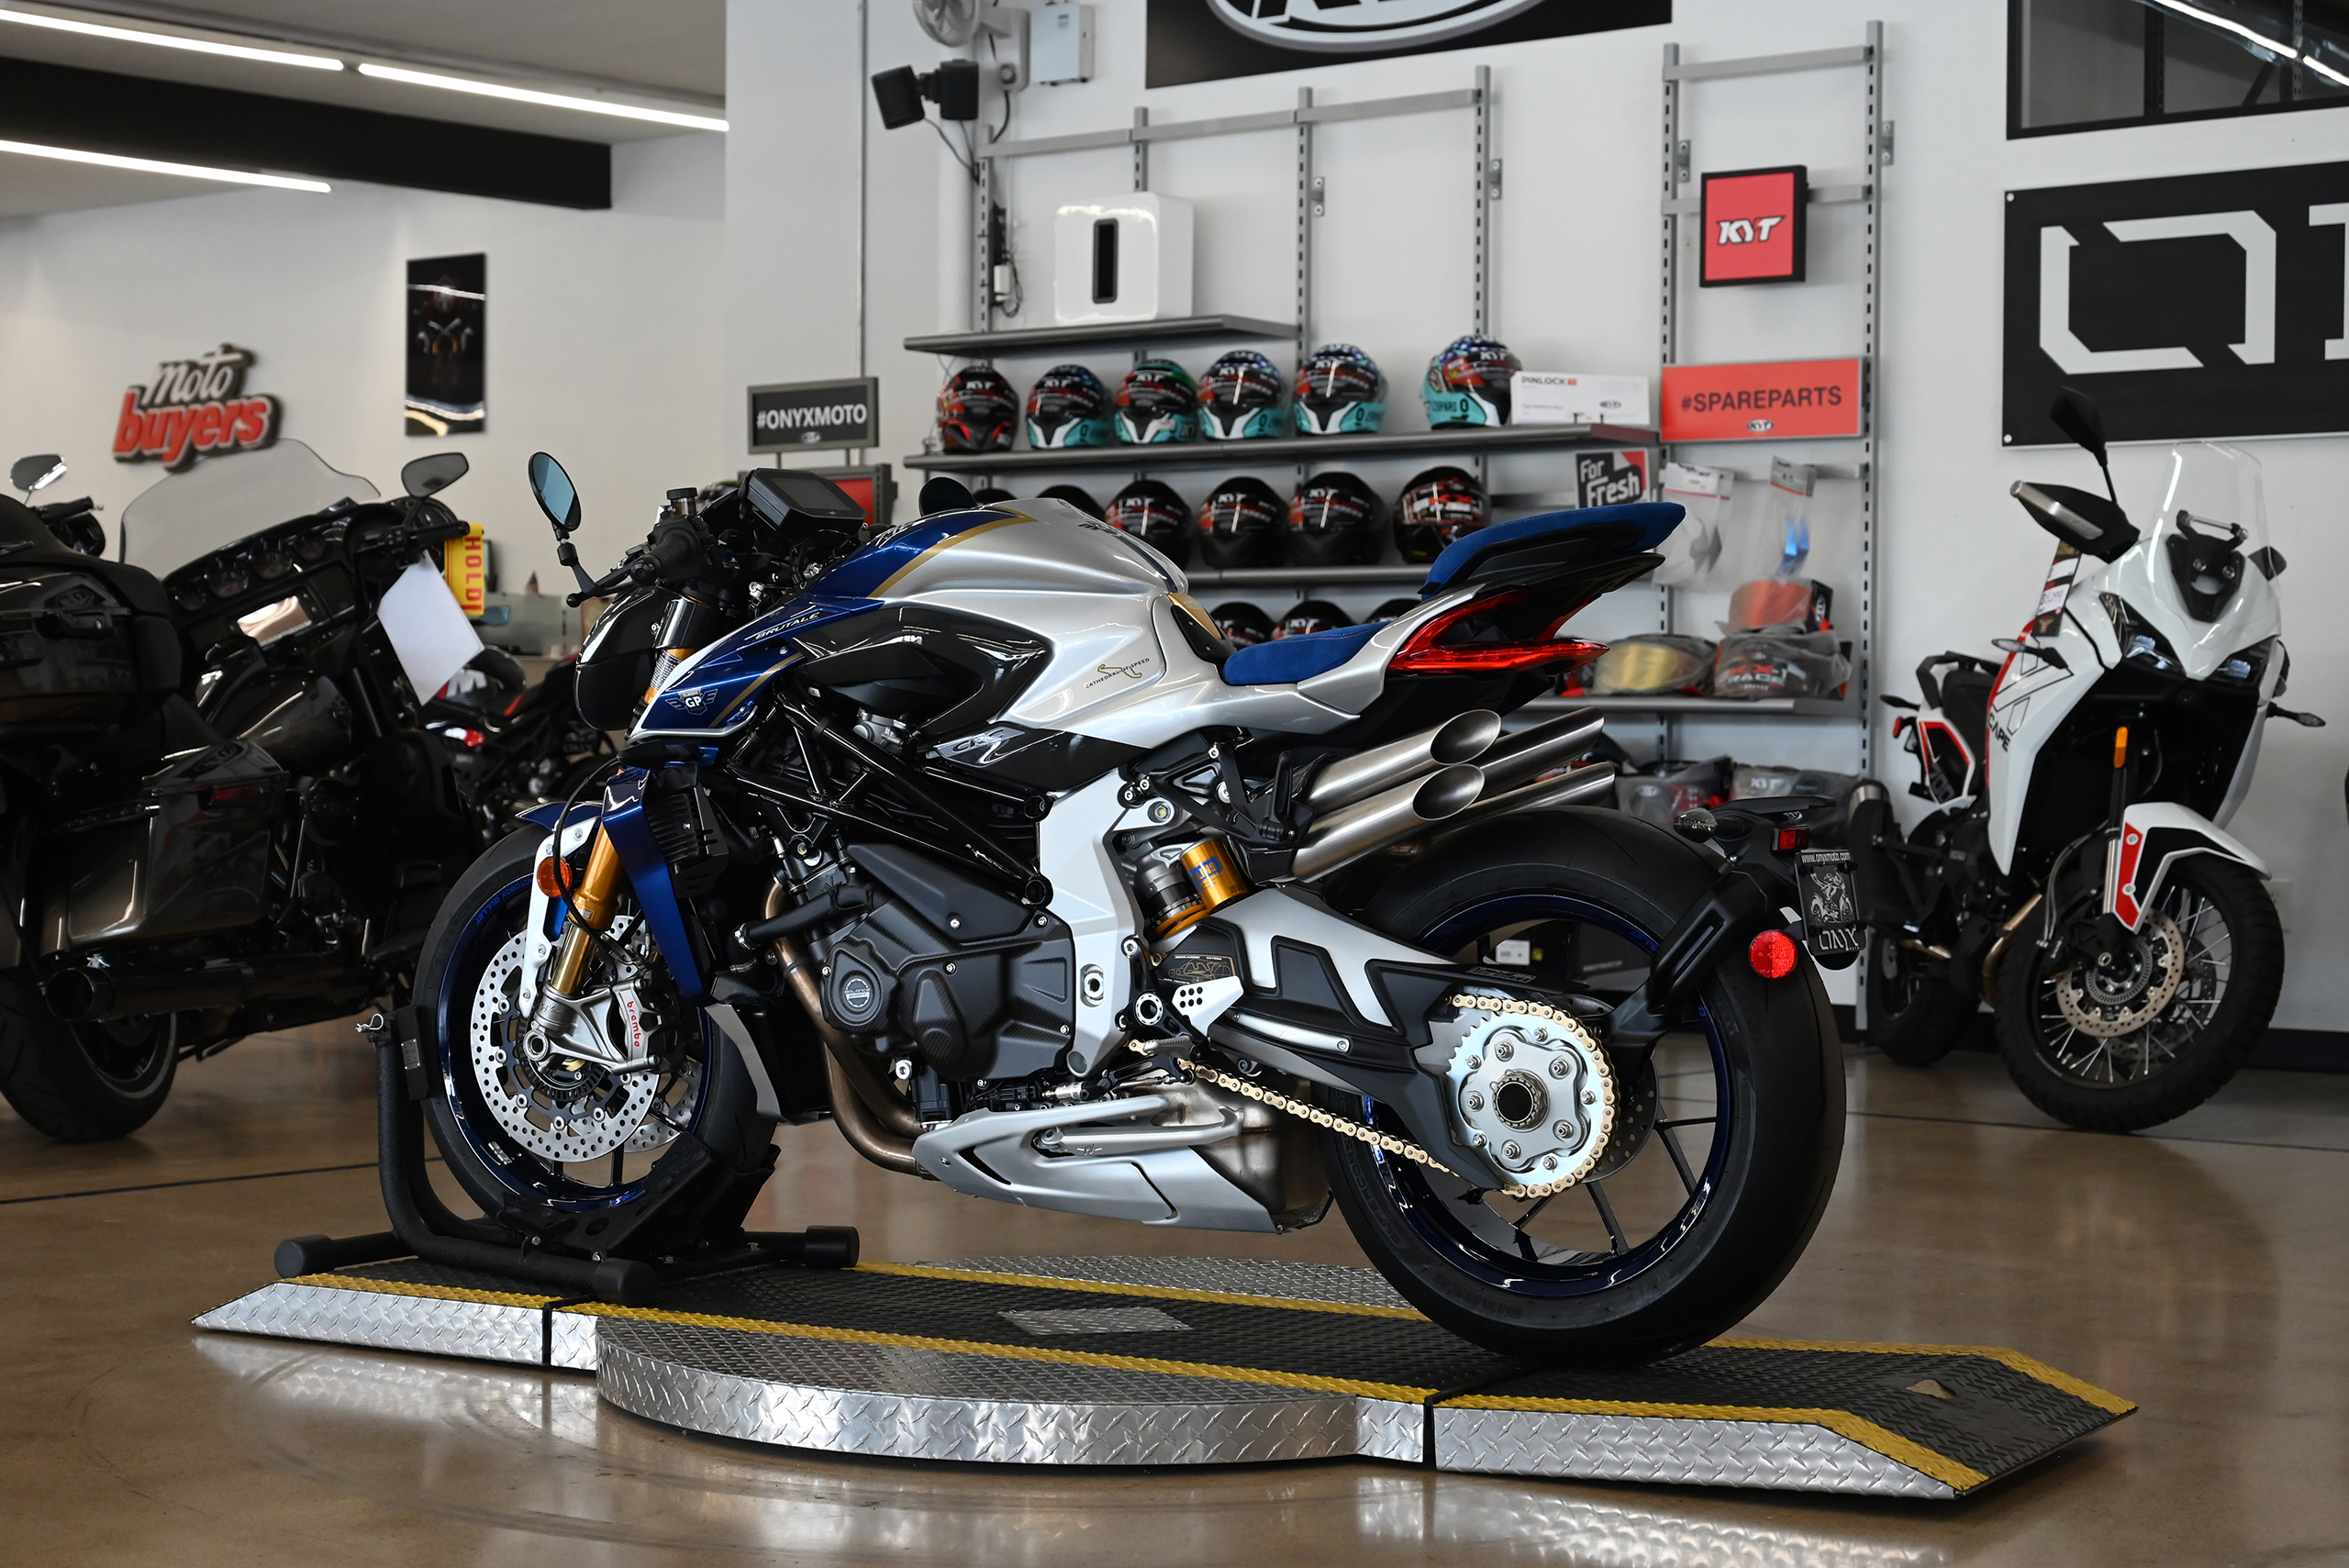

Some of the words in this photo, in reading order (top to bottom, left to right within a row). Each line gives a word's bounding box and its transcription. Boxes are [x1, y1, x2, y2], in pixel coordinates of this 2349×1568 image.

[1717, 216, 1786, 245] KYT
[1480, 350, 1507, 361] KYT
[1521, 375, 1566, 385] PINLOCK
[1681, 385, 1842, 412] #SPAREPARTS
[112, 389, 270, 464] buyers
[756, 403, 867, 429] #ONYXMOTO
[1580, 458, 1605, 483] For
[1586, 471, 1641, 508] Fresh
[755, 611, 820, 640] BRUTALE
[1130, 657, 1151, 669] SPEED
[685, 695, 702, 708] GP
[1987, 712, 2010, 752] CAPE
[1801, 851, 1852, 865] www.onyxmoto.com
[1818, 925, 1859, 951] ONYX
[627, 1000, 641, 1048] brembo
